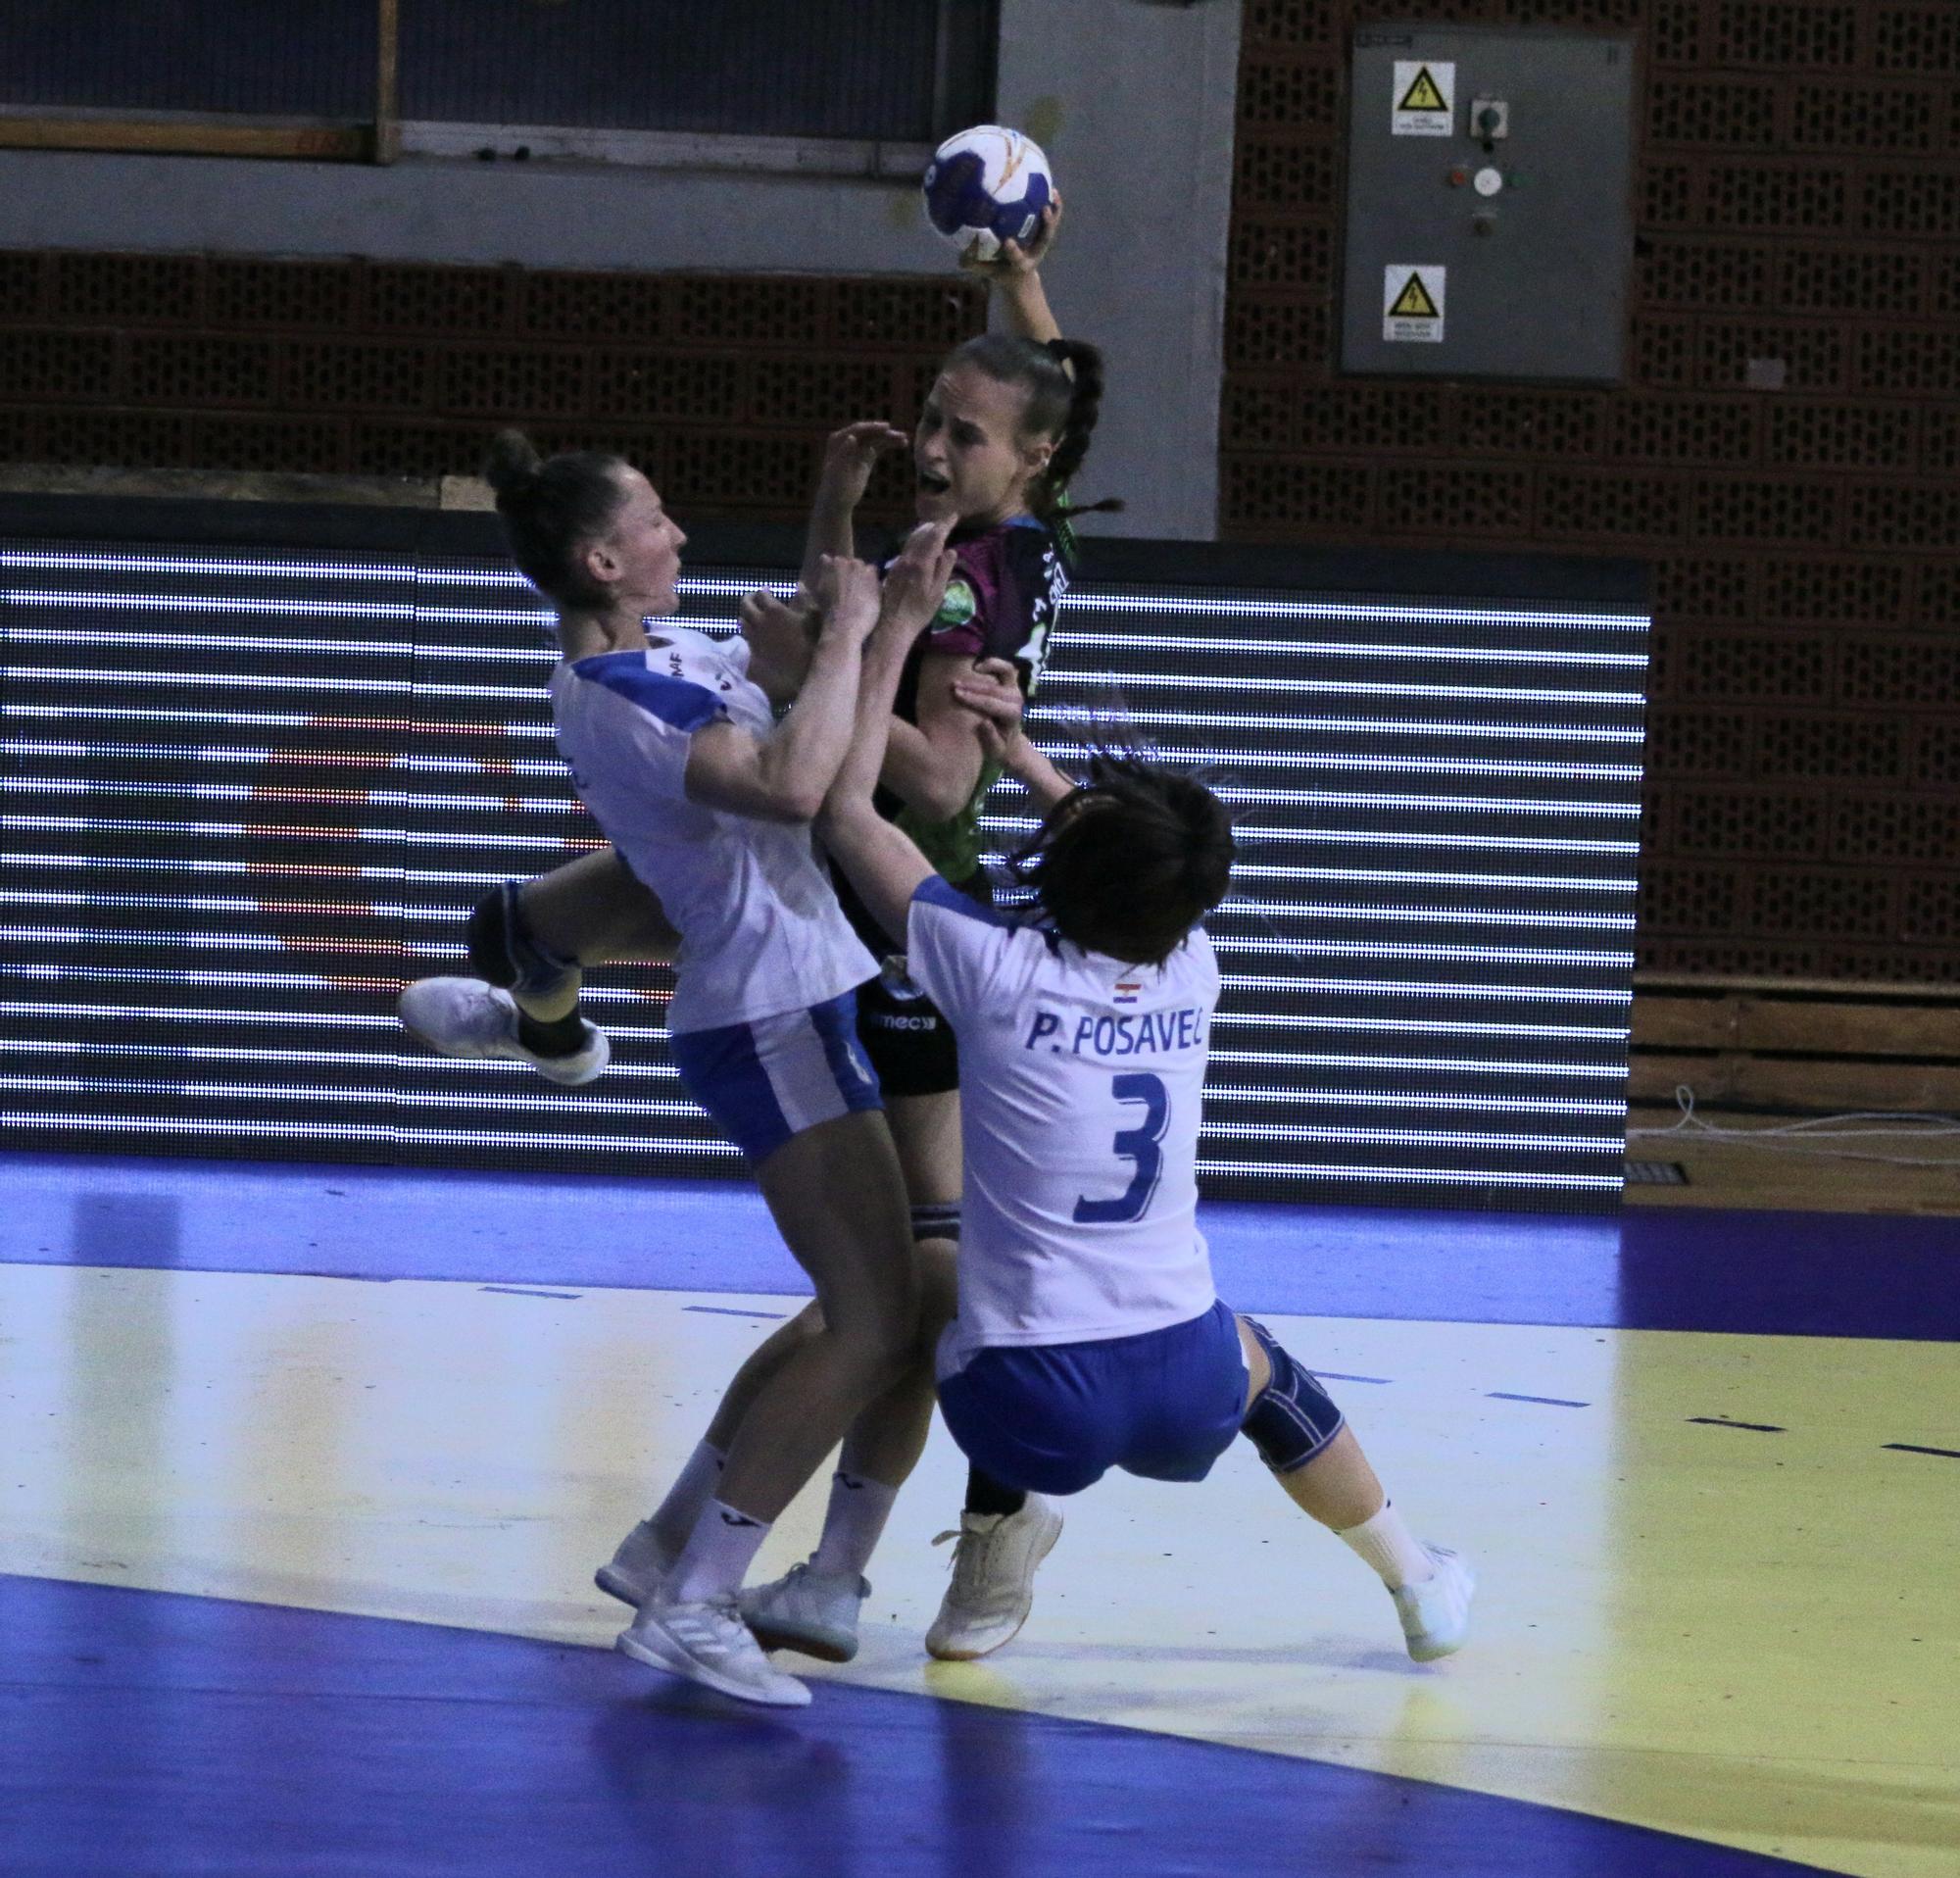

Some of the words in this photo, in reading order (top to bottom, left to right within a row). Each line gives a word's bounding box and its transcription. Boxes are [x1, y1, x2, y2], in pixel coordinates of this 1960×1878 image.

[1025, 1012, 1059, 1054] P.
[1073, 1007, 1203, 1056] POSAVEC
[1073, 1073, 1172, 1223] 3
